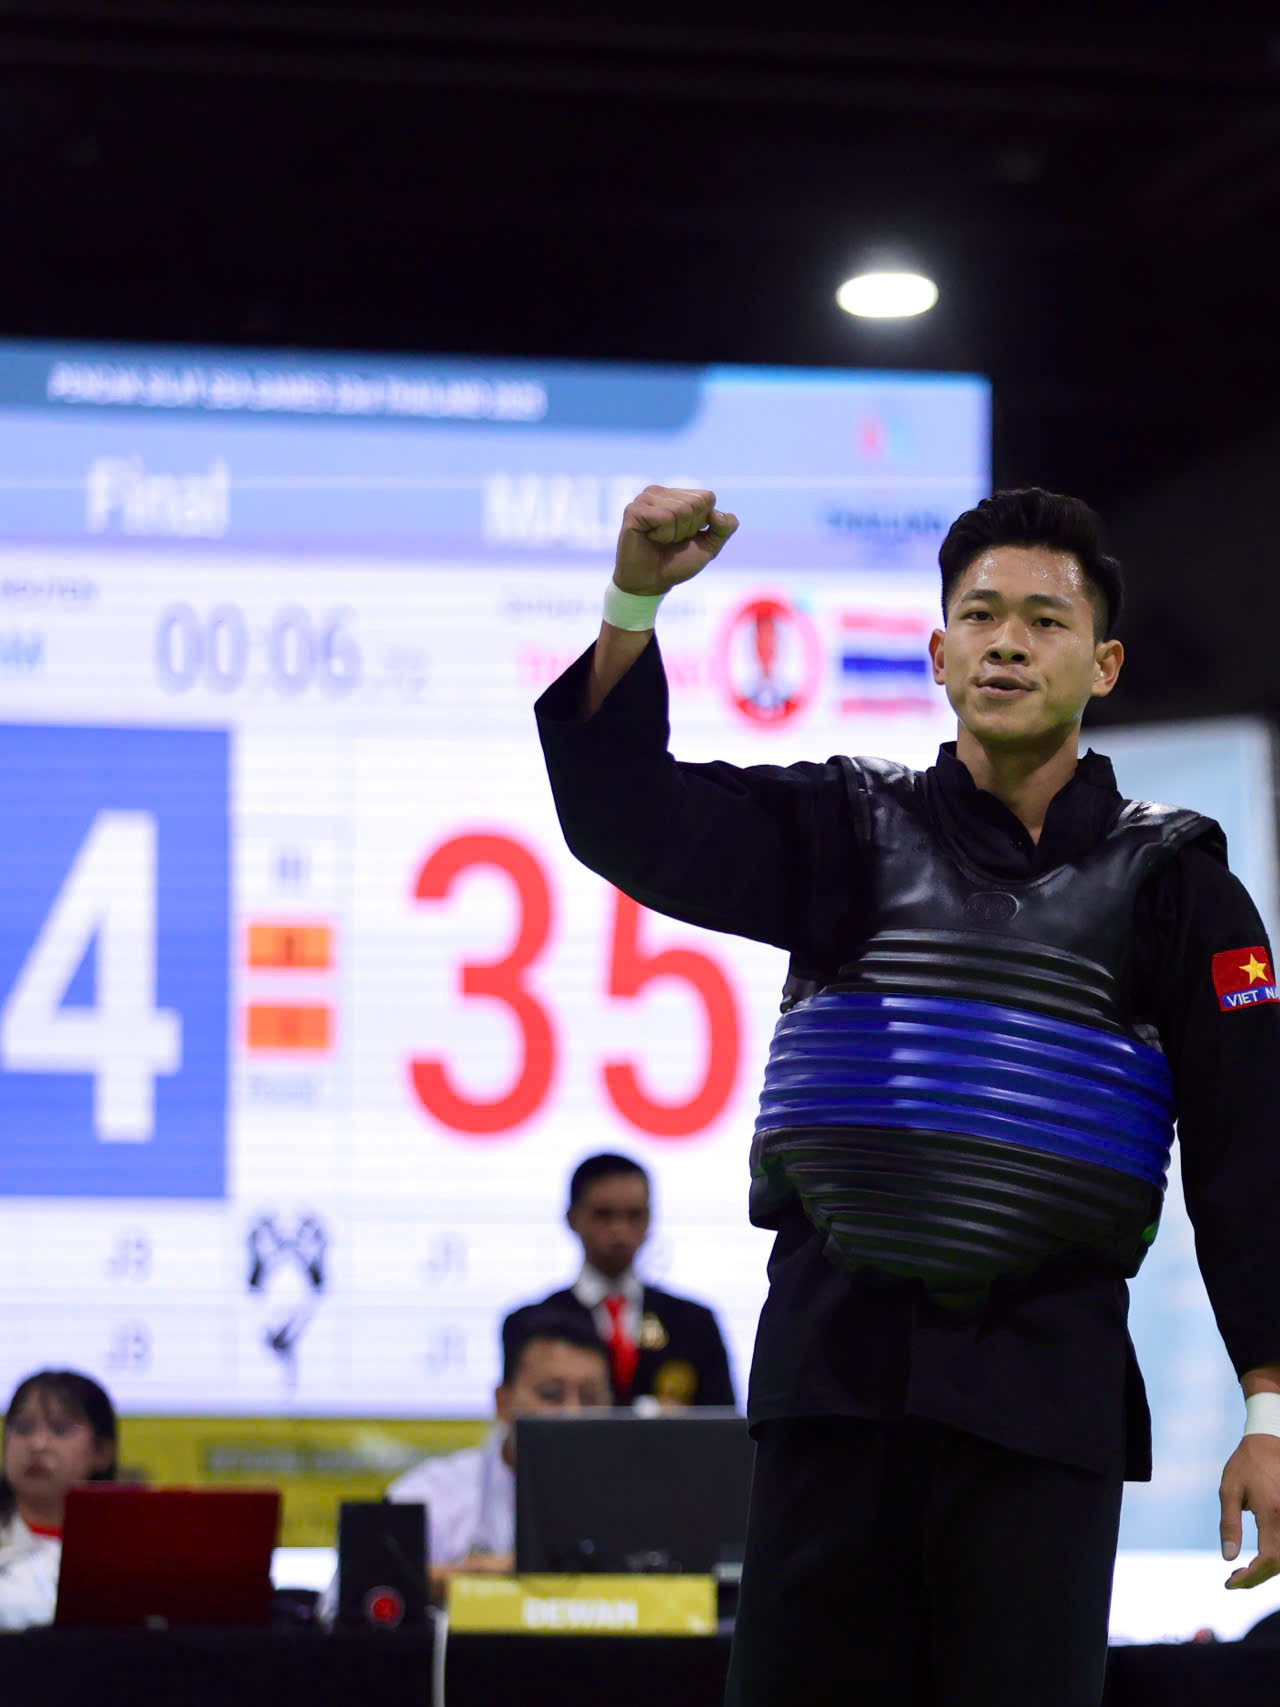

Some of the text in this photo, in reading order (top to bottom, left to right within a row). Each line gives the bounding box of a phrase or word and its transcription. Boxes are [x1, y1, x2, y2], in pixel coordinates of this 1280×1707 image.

[88, 455, 230, 538] Final
[2, 808, 182, 1142] 4
[408, 832, 745, 1138] 35
[1226, 990, 1258, 1007] VIET
[523, 1598, 638, 1629] DEWAN
